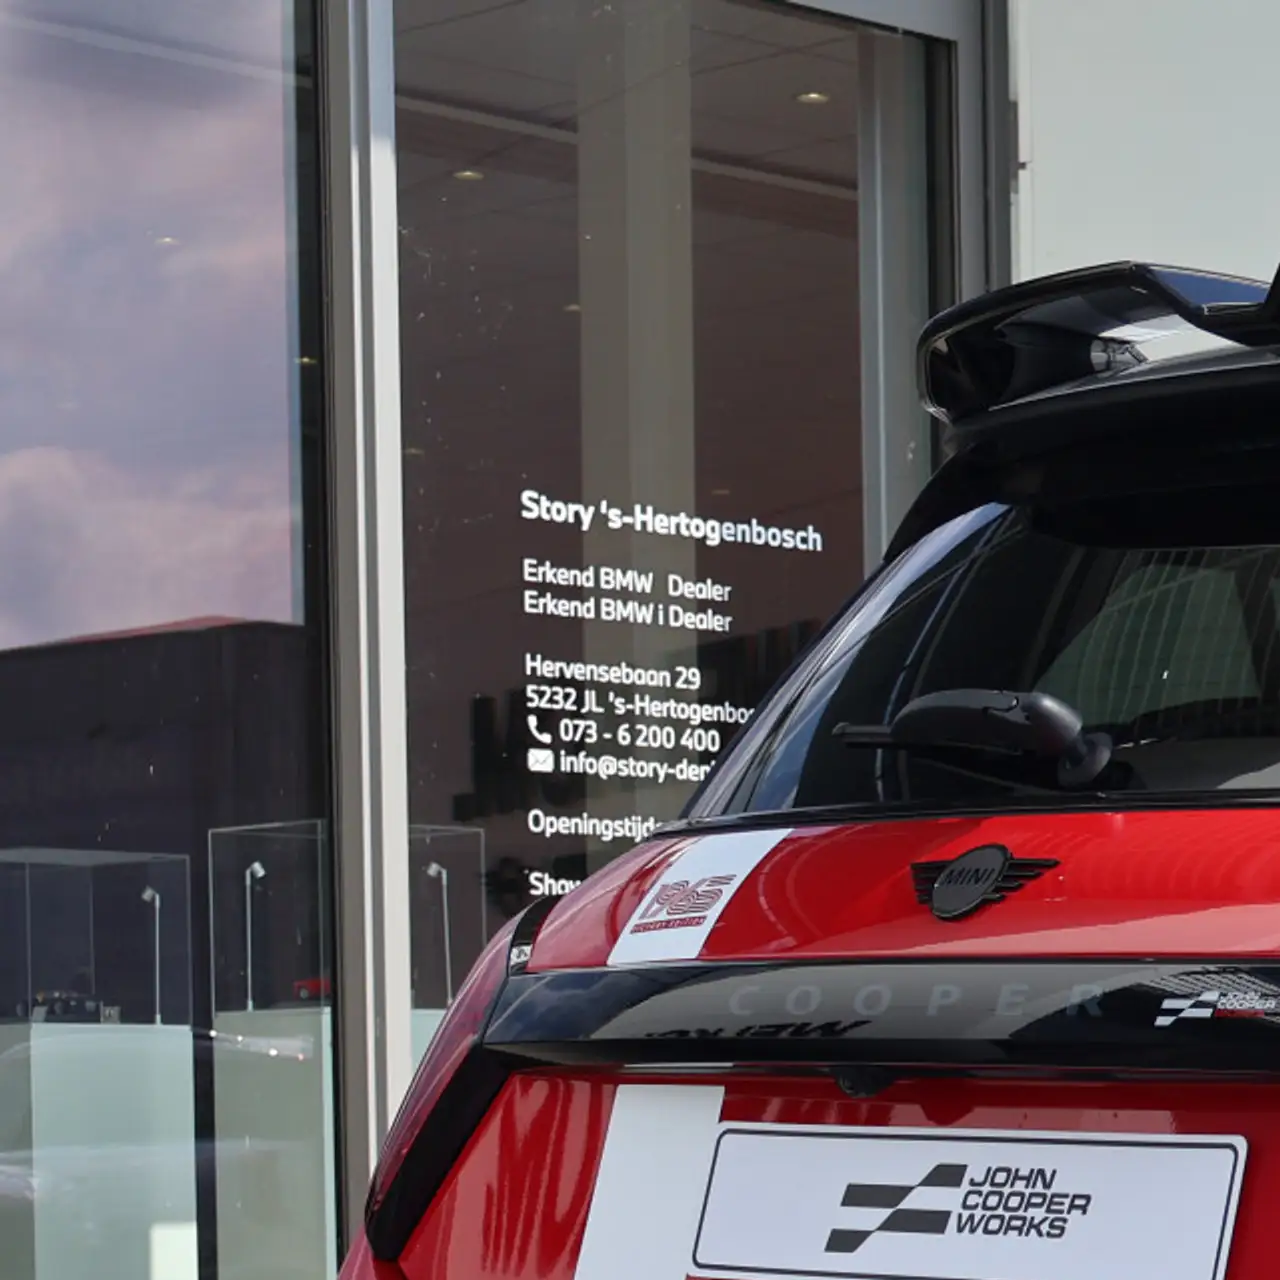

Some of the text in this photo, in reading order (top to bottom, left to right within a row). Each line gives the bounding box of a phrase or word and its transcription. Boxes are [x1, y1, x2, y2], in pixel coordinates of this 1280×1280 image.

[520, 489, 823, 552] Story 's-Hertogenbosch
[522, 558, 732, 601] Erkend BMW Dealer
[523, 589, 733, 632] Erkend BMW i Dealer
[525, 652, 701, 690] Hervensebaan 29
[525, 684, 577, 711] 5232
[580, 689, 605, 713] JL
[559, 718, 597, 743] 073
[616, 722, 632, 746] 6
[635, 723, 675, 749] 200
[680, 727, 721, 752] 400
[559, 749, 716, 784] info@story-den
[527, 808, 663, 843] Openingstijd
[940, 867, 997, 885] MINI
[729, 983, 1104, 1017] COOPER
[967, 1165, 1057, 1190] JOHN
[960, 1189, 1093, 1216] COOPER
[956, 1212, 1069, 1239] WORKS
